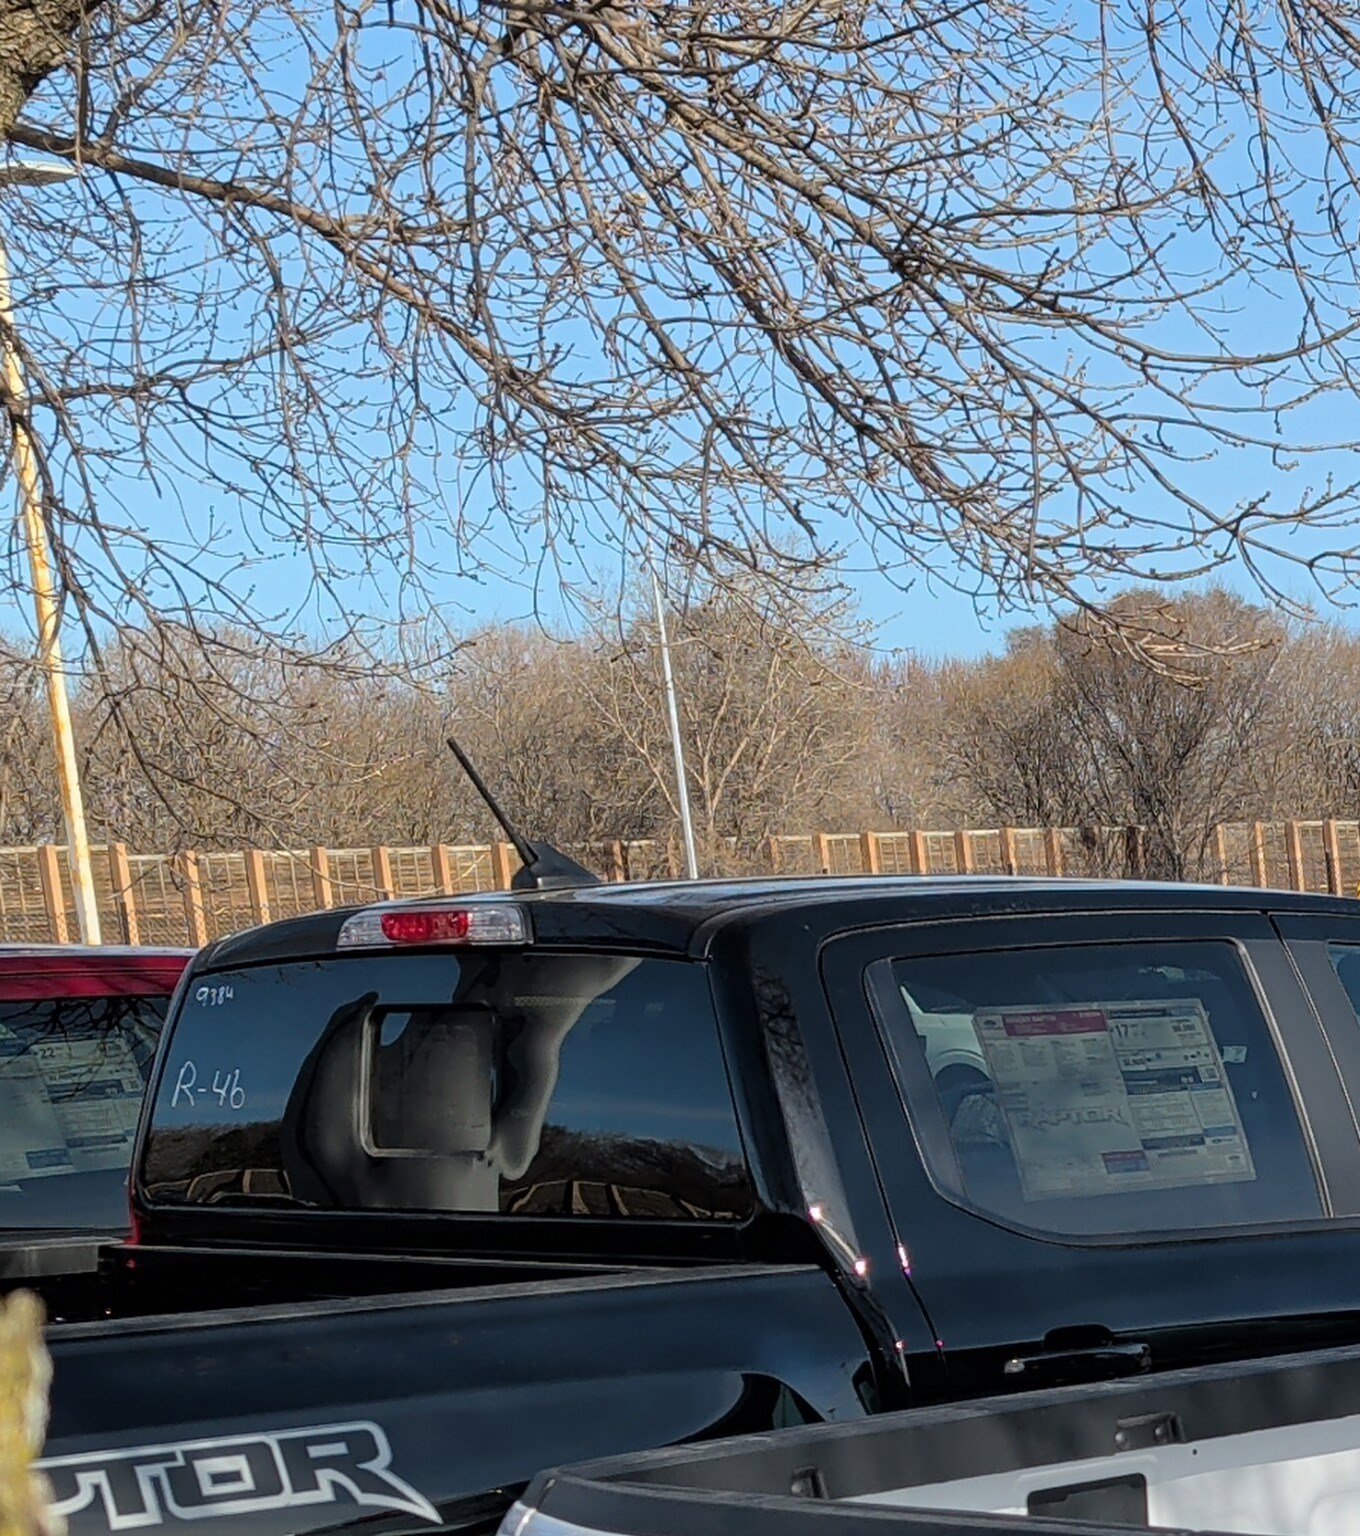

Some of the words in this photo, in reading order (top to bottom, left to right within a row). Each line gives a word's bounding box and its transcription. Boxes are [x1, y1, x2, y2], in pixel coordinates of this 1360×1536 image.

[1116, 1024, 1128, 1038] 17
[40, 1047, 55, 1058] 22
[171, 1060, 245, 1109] R-46
